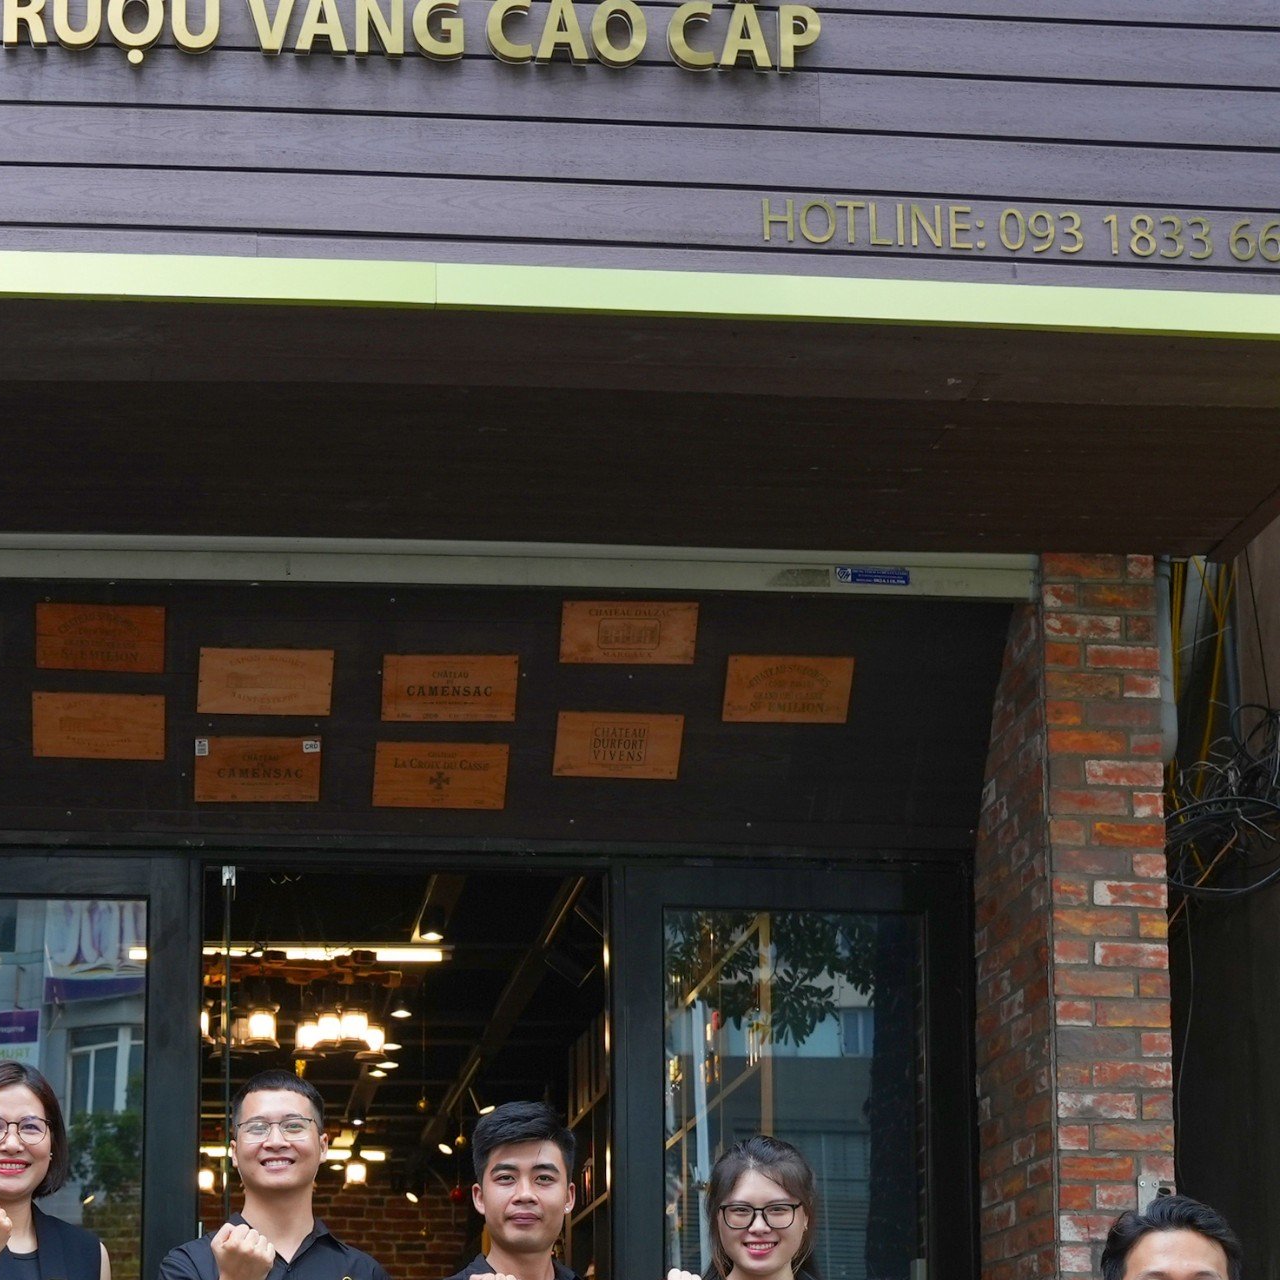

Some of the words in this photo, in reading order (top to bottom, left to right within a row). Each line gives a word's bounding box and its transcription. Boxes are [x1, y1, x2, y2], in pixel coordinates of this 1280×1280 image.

[249, 0, 465, 60] VANG
[487, 0, 647, 67] CAO
[762, 199, 986, 250] HOTLINE:
[999, 208, 1085, 254] 093
[1102, 213, 1214, 260] 1833
[406, 685, 493, 697] CAMENSAC
[593, 738, 644, 749] DURFORT
[592, 749, 643, 762] VIVENS
[217, 768, 304, 779] CAMENSAC
